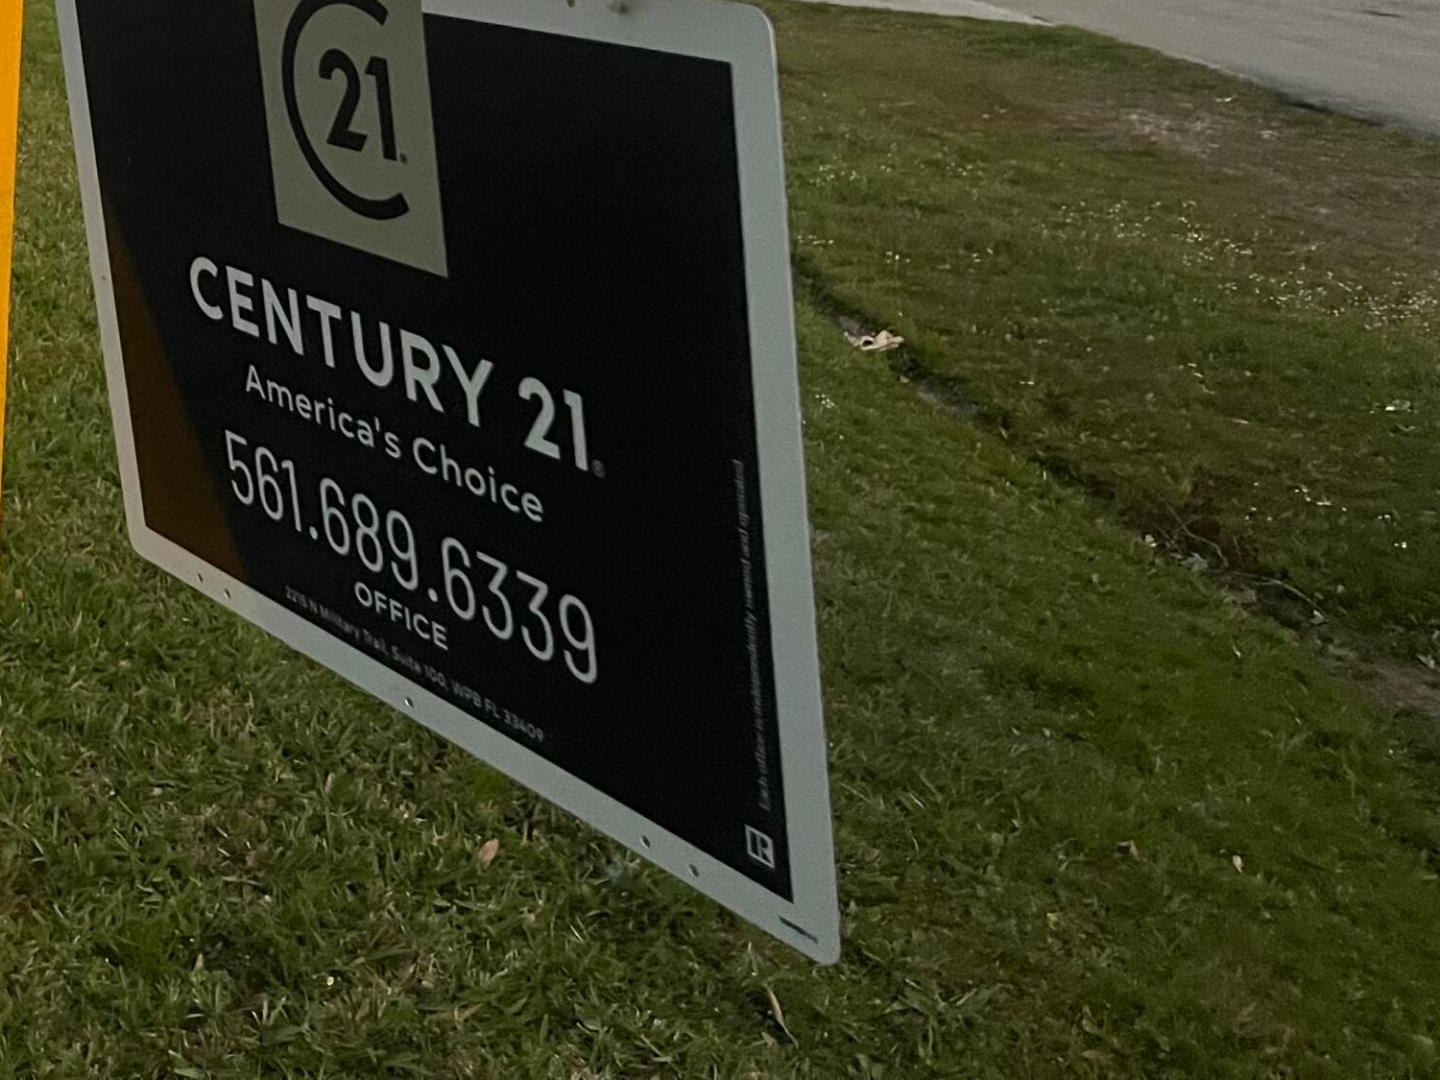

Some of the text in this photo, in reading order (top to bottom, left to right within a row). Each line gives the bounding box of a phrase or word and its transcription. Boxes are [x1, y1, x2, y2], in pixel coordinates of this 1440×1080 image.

[189, 256, 590, 471] CENTURY 21
[245, 365, 545, 522] America's Choice
[225, 429, 598, 684] 561.689.6339
[354, 581, 449, 651] OFFICE
